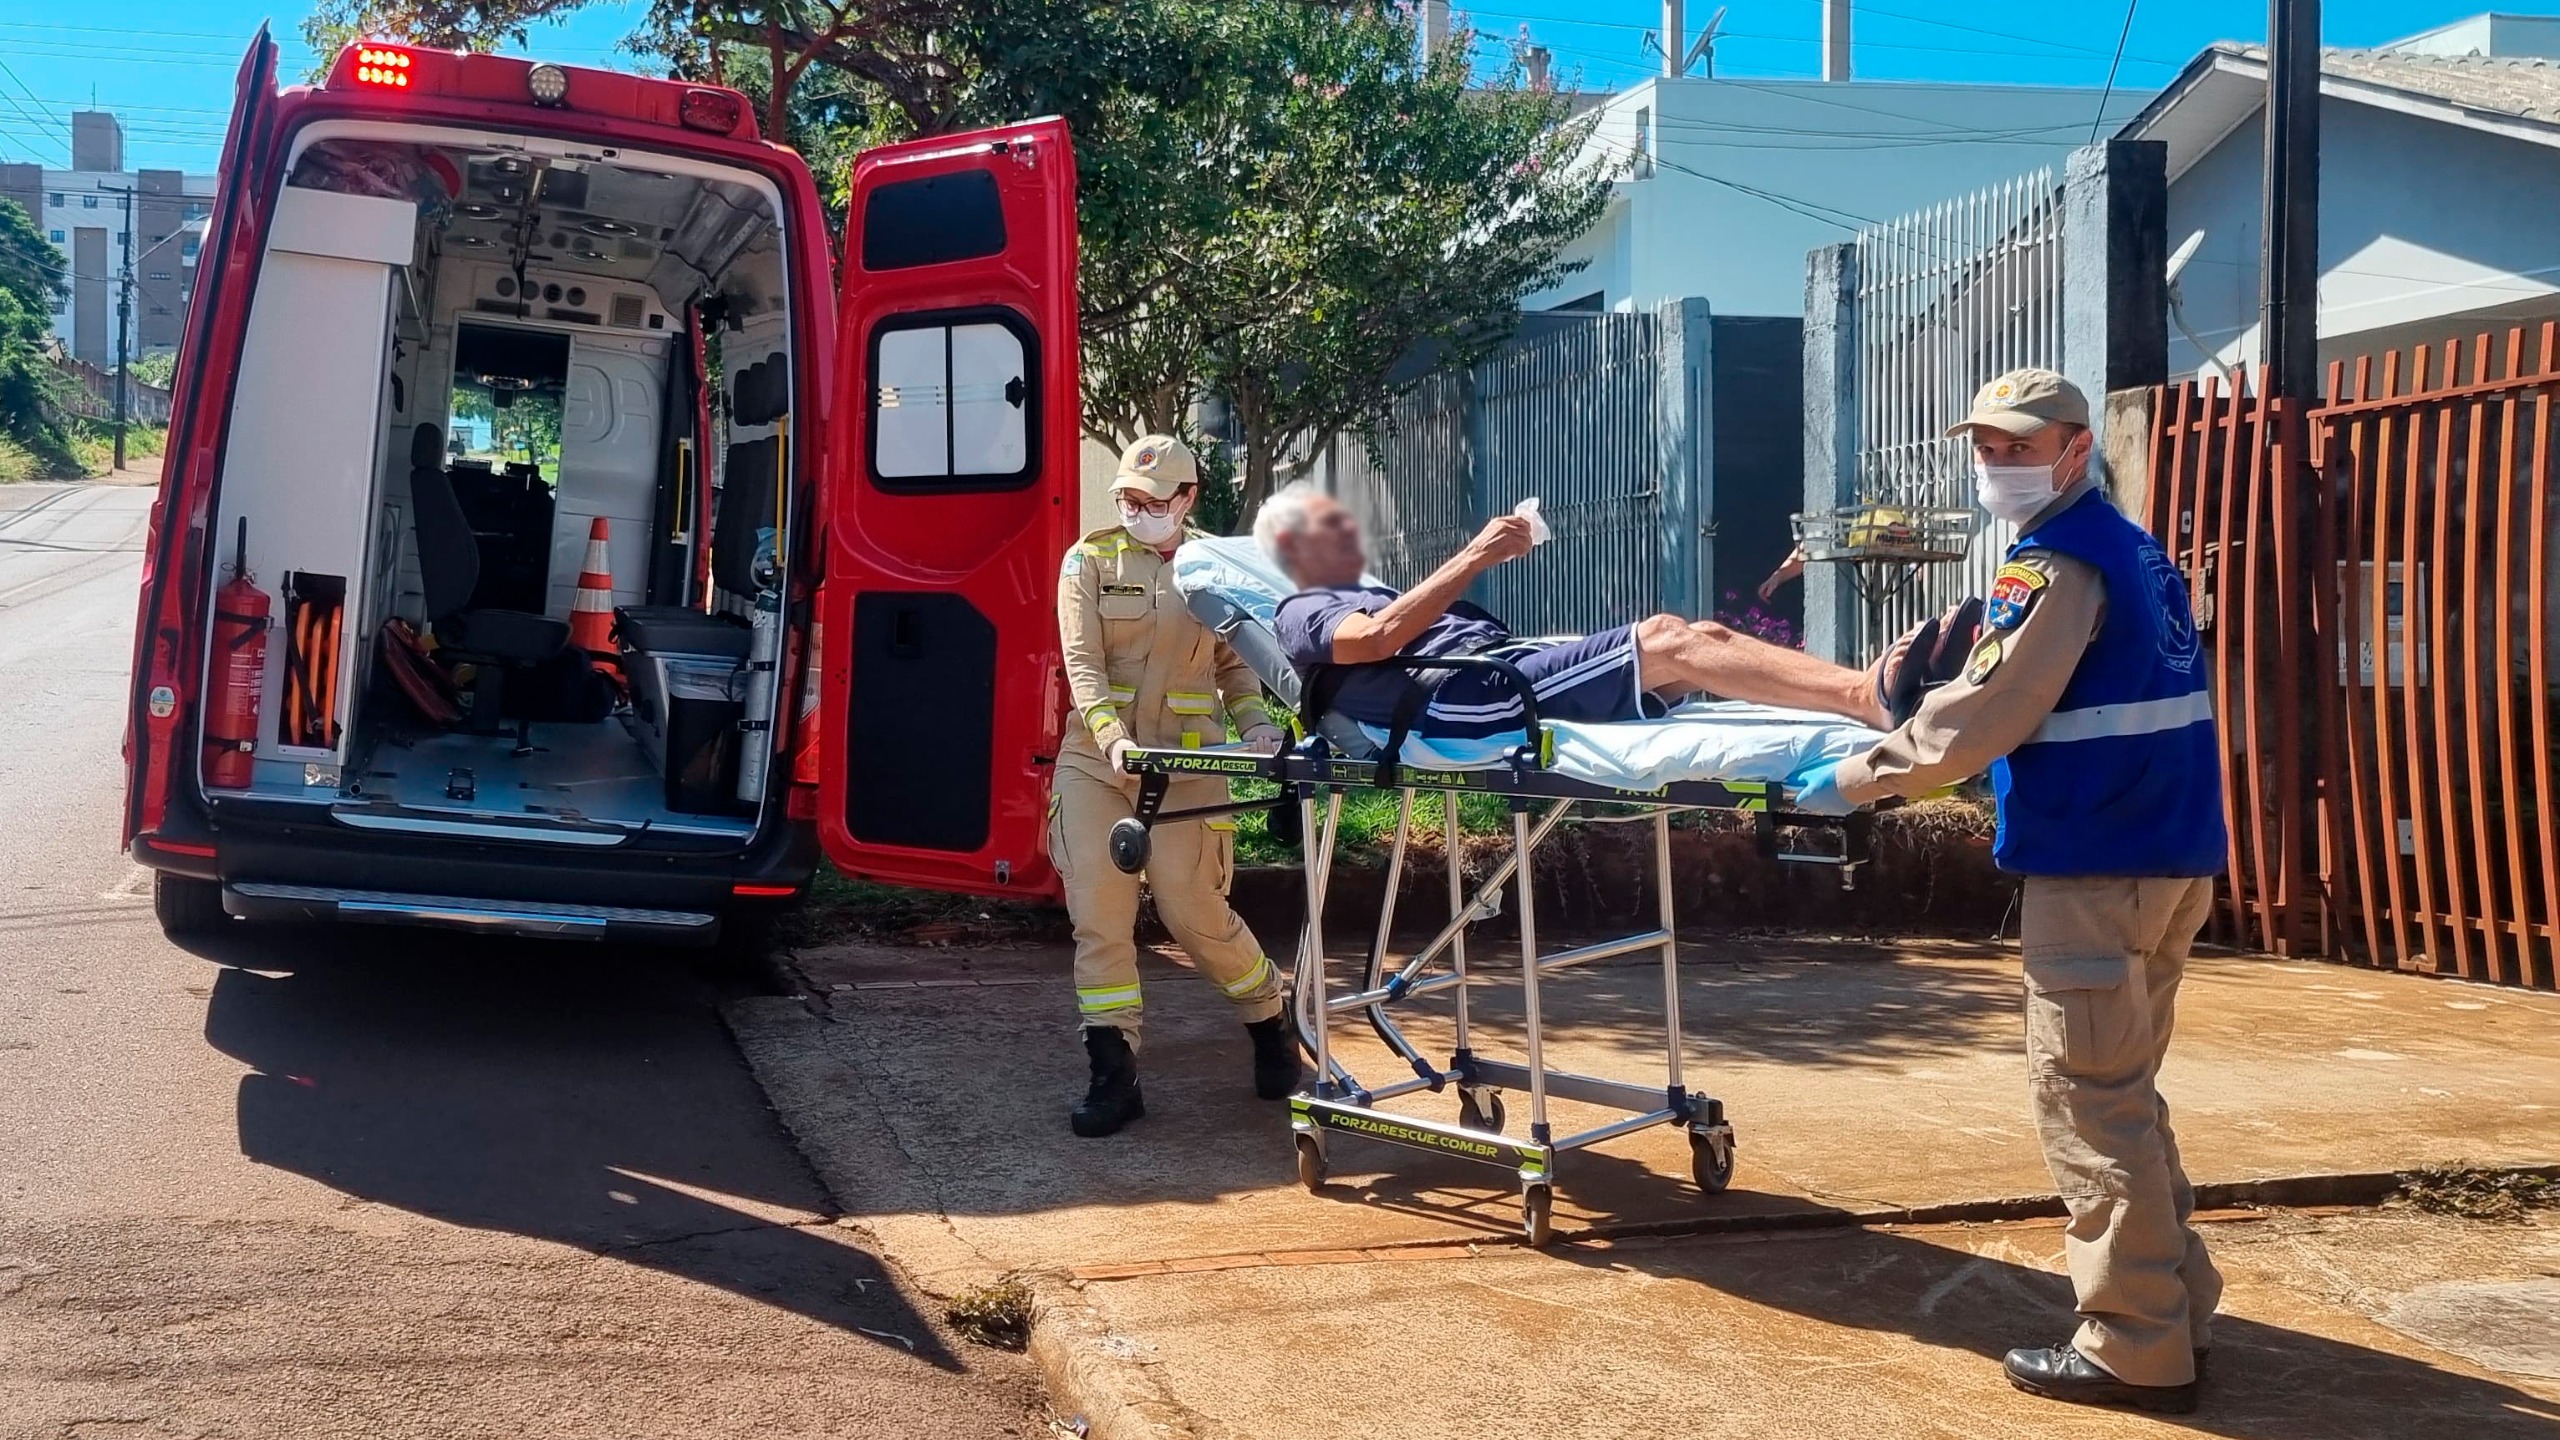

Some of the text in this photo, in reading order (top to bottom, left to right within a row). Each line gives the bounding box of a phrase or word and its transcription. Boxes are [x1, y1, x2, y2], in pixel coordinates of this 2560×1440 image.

[1173, 757, 1256, 771] FORZA RESCUE
[1330, 1113, 1498, 1158] FORZARESCUE.COM.BR
